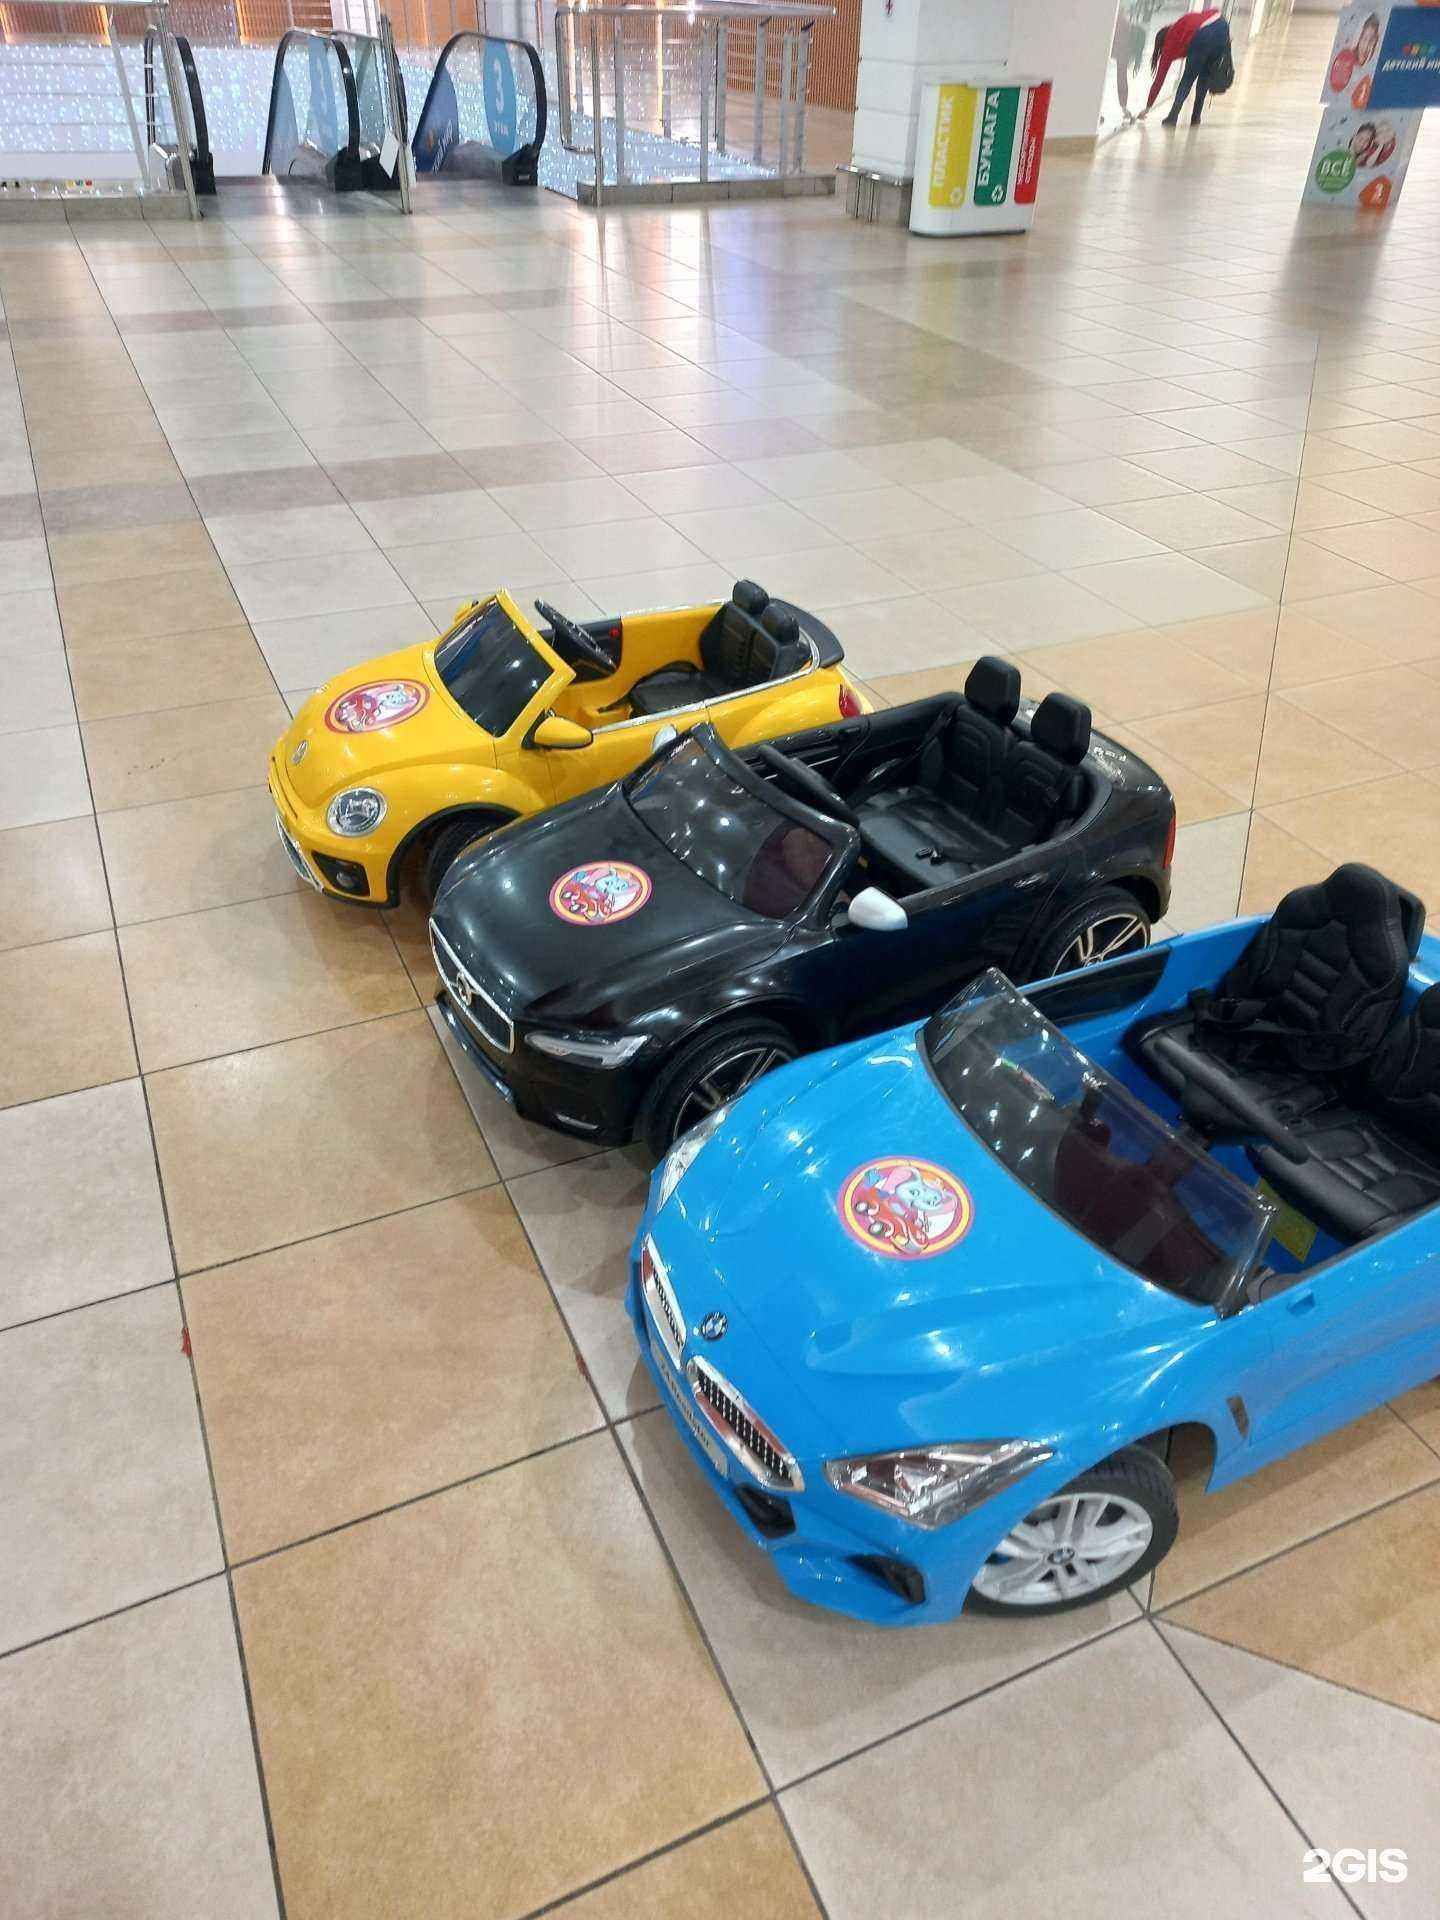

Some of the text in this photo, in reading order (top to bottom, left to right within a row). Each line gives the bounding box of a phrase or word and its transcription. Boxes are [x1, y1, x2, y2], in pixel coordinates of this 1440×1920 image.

[493, 57, 505, 114] 3
[935, 95, 953, 187] ПЛАСТИК
[978, 90, 1001, 187] БУМАГА
